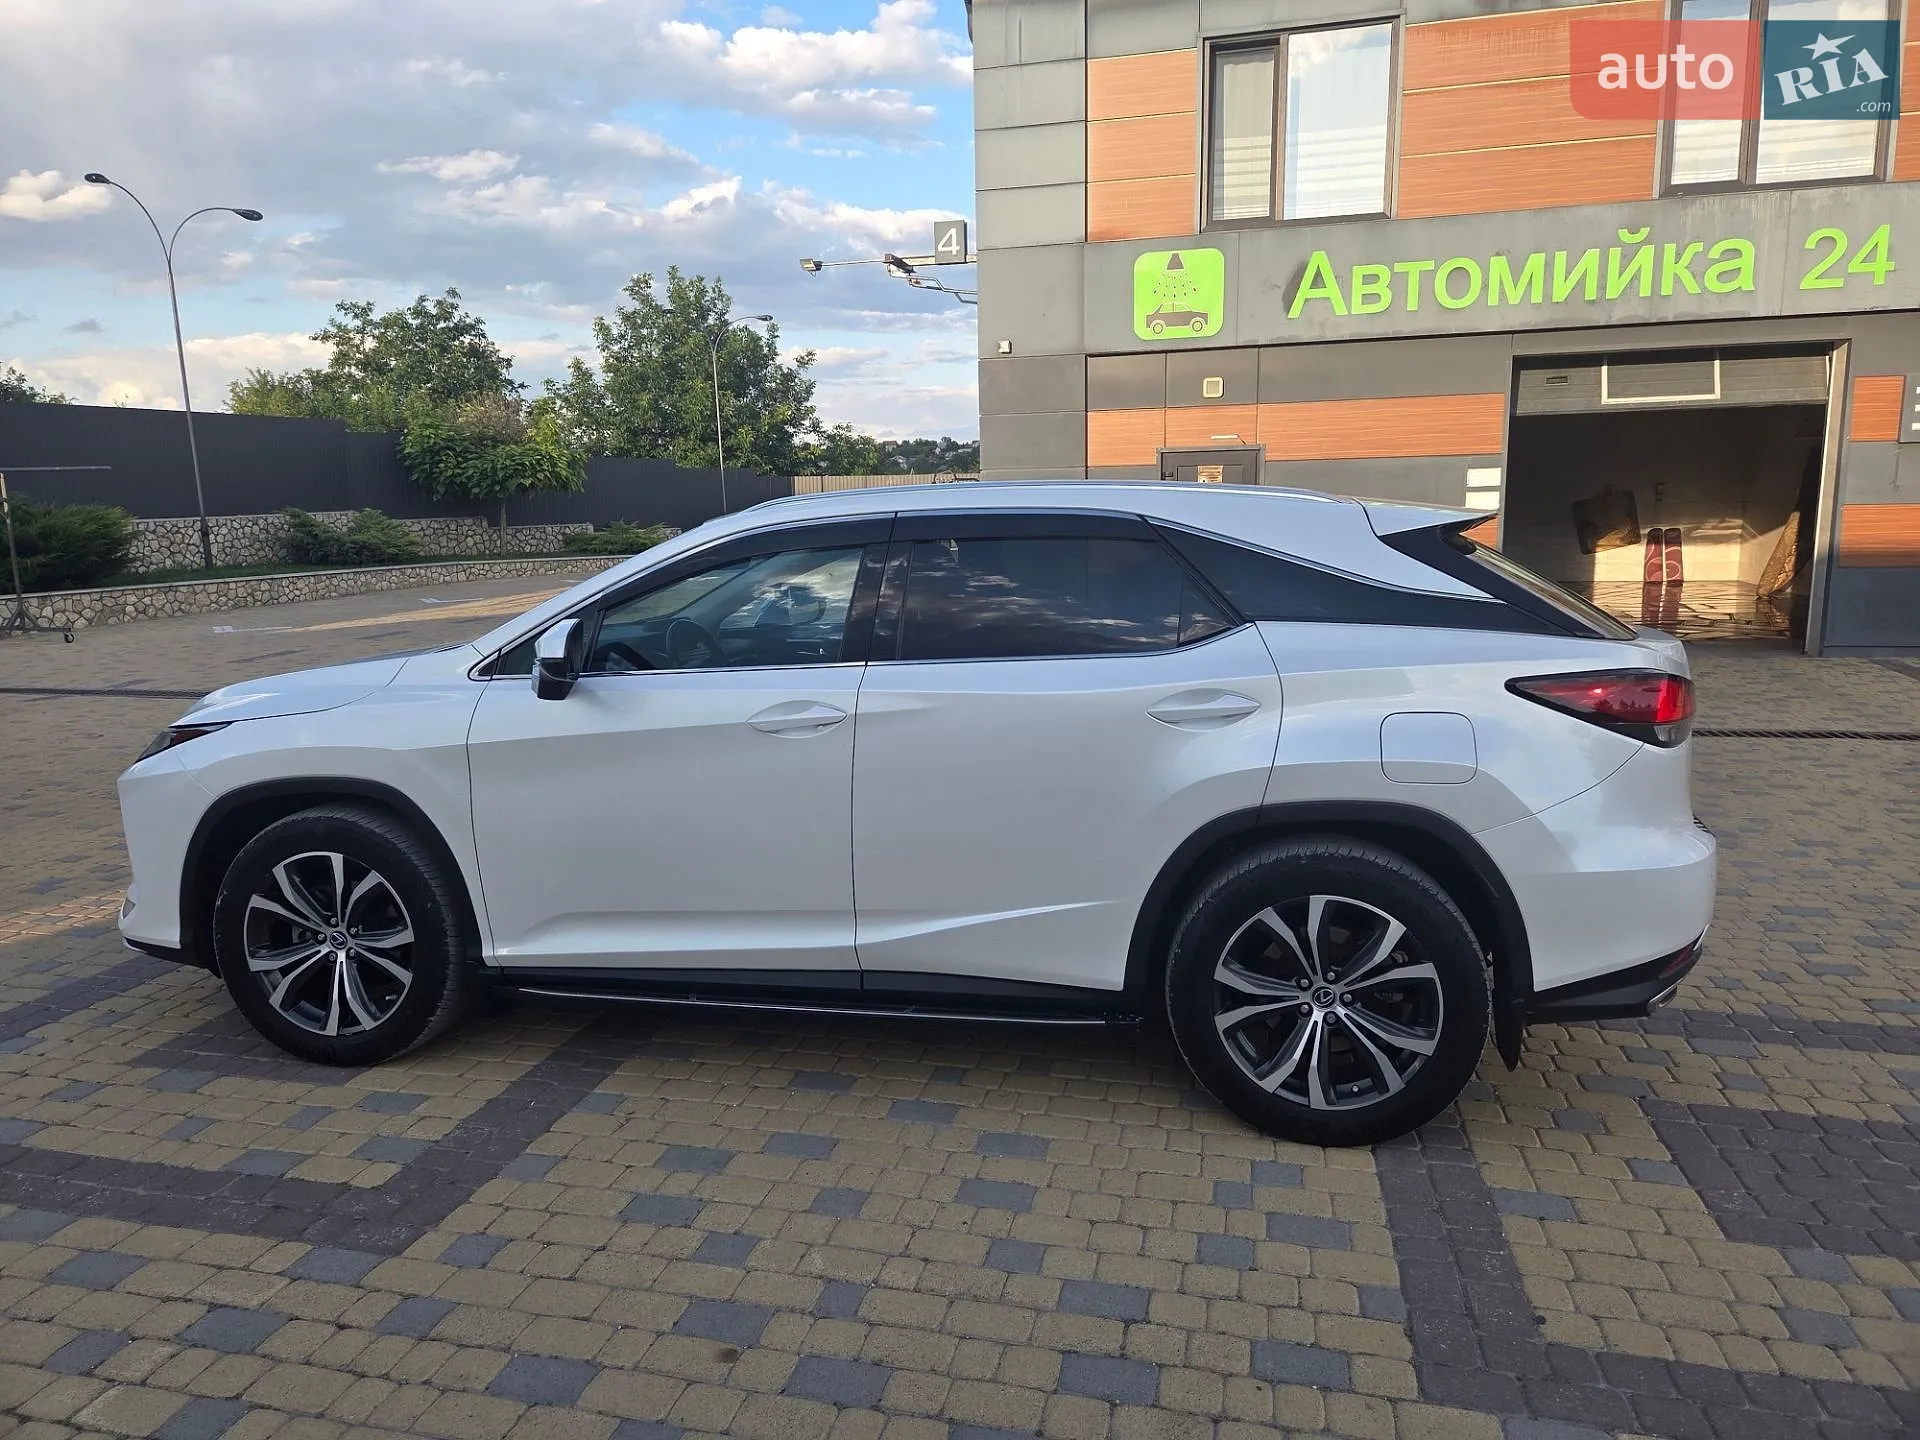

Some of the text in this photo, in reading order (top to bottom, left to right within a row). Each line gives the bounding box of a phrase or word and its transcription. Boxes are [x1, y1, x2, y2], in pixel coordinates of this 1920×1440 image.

[937, 227, 960, 255] 4
[1288, 225, 1895, 319] Автомийка 24
